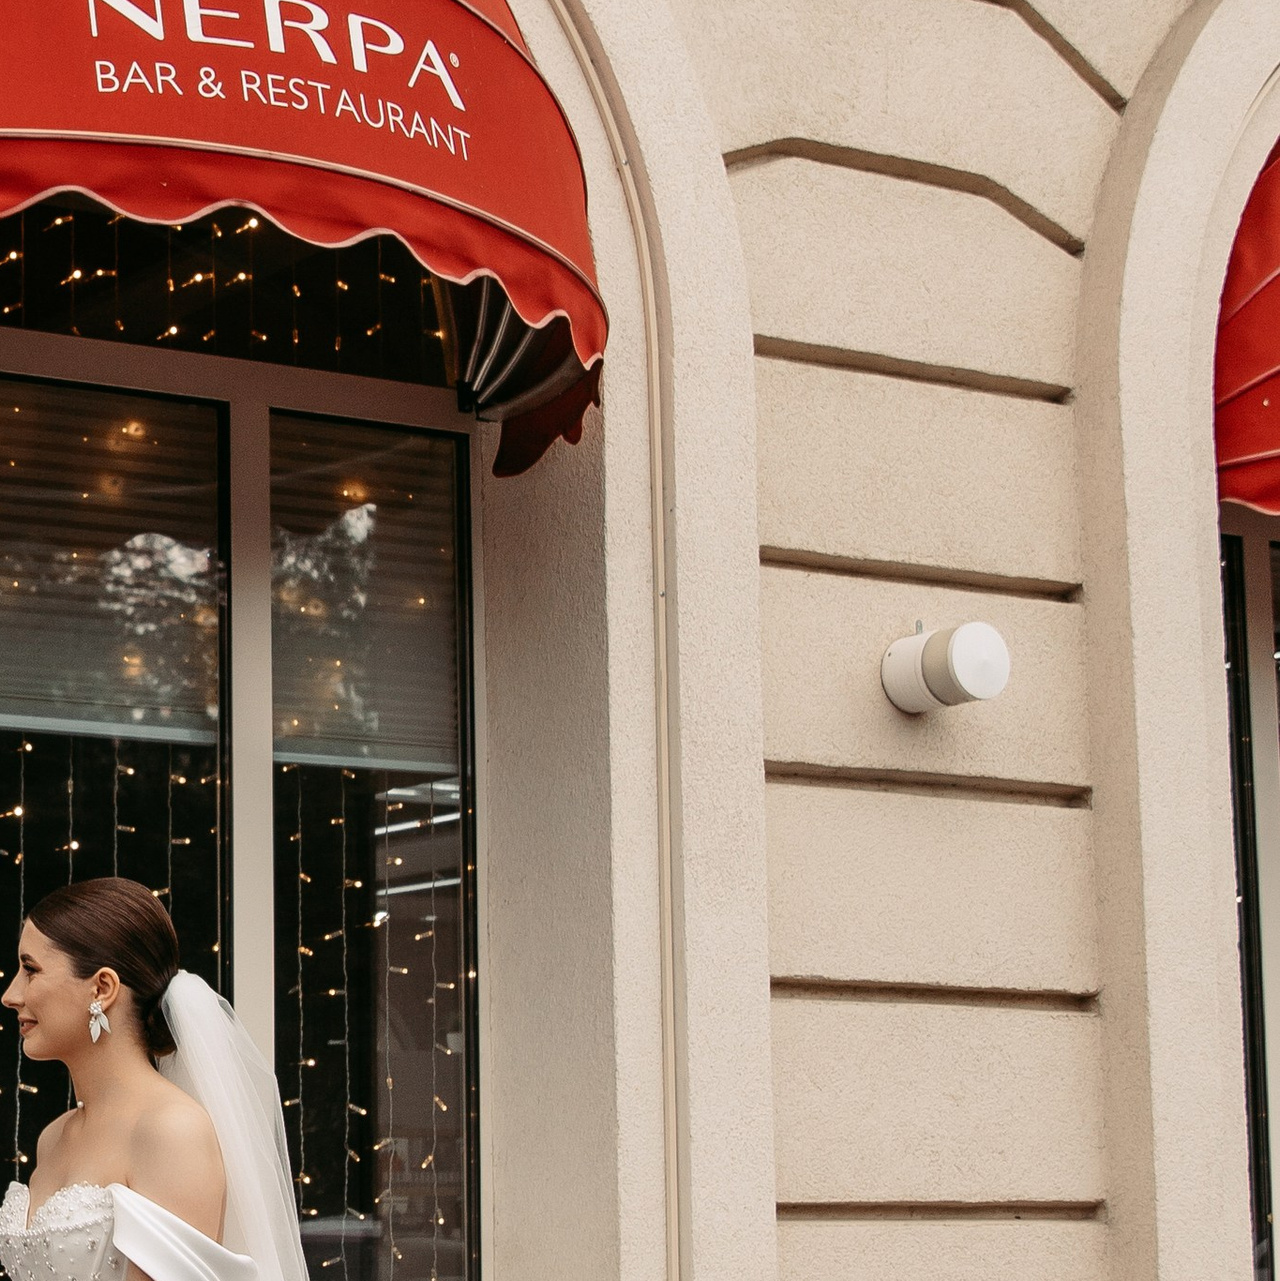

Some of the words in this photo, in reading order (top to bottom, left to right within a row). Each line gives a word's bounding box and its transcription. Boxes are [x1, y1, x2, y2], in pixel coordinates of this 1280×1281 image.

[94, 60, 184, 96] BAR
[197, 66, 226, 99] &
[240, 70, 471, 161] RESTAURANT
